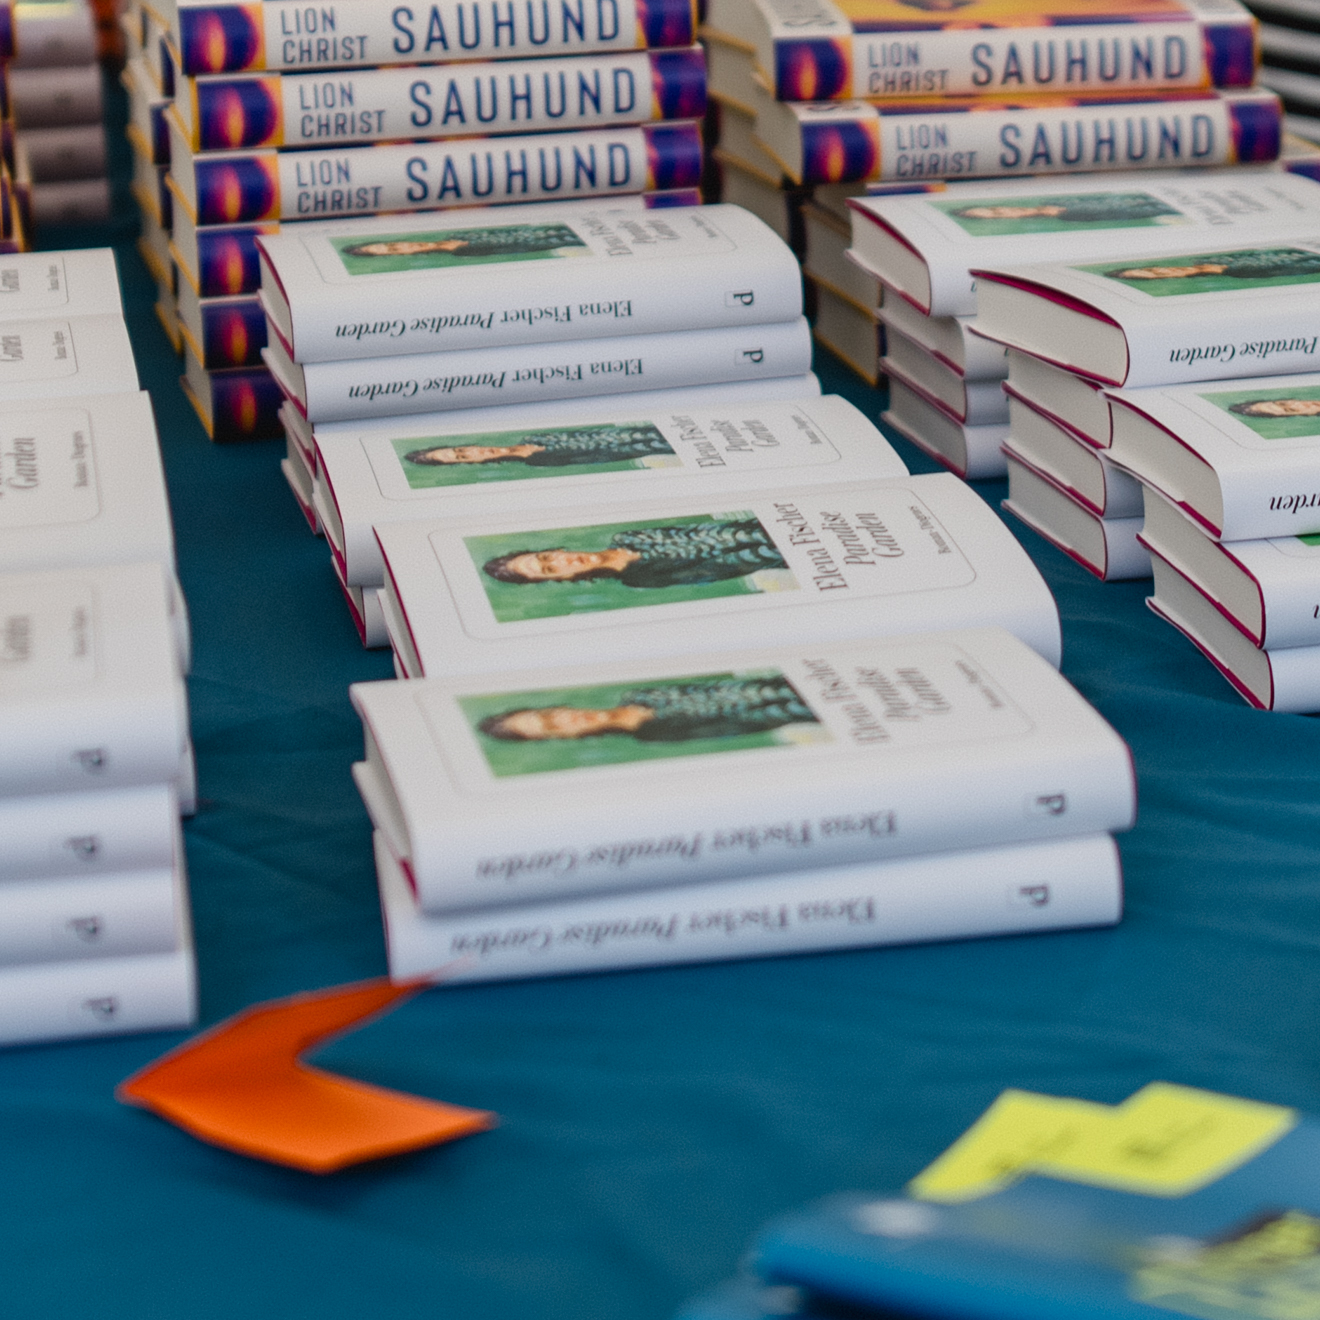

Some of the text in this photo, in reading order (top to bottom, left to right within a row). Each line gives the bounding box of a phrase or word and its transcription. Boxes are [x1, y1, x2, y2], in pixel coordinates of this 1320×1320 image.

[281, 7, 336, 36] LION
[283, 36, 368, 64] CHRIST
[868, 41, 920, 68] LION
[972, 35, 1186, 86] SAUHUND
[299, 81, 354, 110] LION
[868, 69, 949, 93] CHRIST
[410, 68, 635, 127] SAUHUND
[301, 110, 385, 138] CHRIST
[897, 123, 947, 150] LION
[999, 114, 1215, 168] SAUHUND
[295, 158, 350, 187] LION
[406, 143, 630, 202] SAUHUND
[897, 151, 978, 177] CHRIST
[297, 187, 382, 214] CHRIST
[335, 300, 632, 339] Elena Fischer Paradise Garden
[1170, 345, 1236, 364] Garden
[1240, 336, 1318, 359] Paradise
[349, 358, 643, 399] Elena Fischer Paradise Garden
[5, 438, 39, 489] Garden
[773, 503, 849, 591] Elena Fischer
[820, 511, 876, 565] Paradise
[856, 513, 904, 558] Garden
